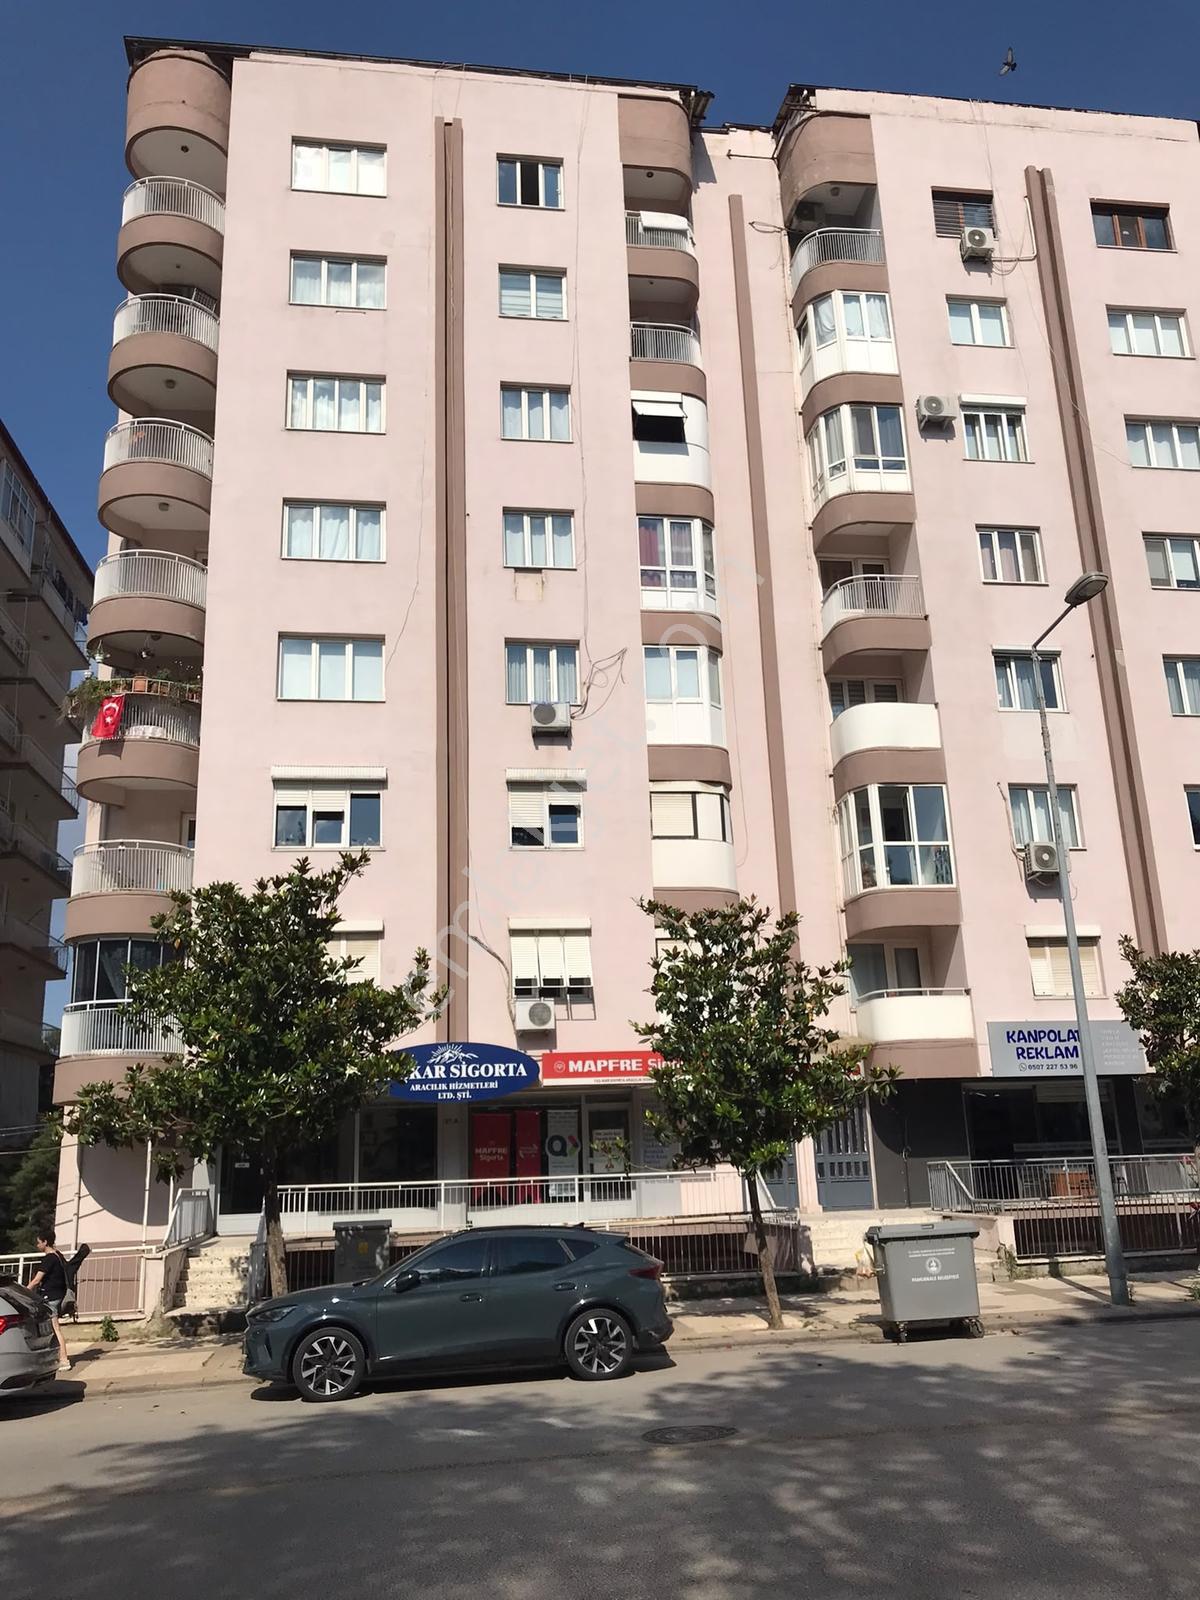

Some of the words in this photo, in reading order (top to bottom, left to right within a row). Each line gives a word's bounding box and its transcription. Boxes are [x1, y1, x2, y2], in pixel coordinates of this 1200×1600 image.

[1016, 1045, 1080, 1060] REKLAM
[449, 1061, 528, 1079] SİGORTA
[568, 1058, 643, 1073] MAPFRE
[410, 1083, 448, 1092] ARACILIK
[448, 1080, 499, 1090] HİZMETLERİ
[437, 1092, 456, 1100] LTD.
